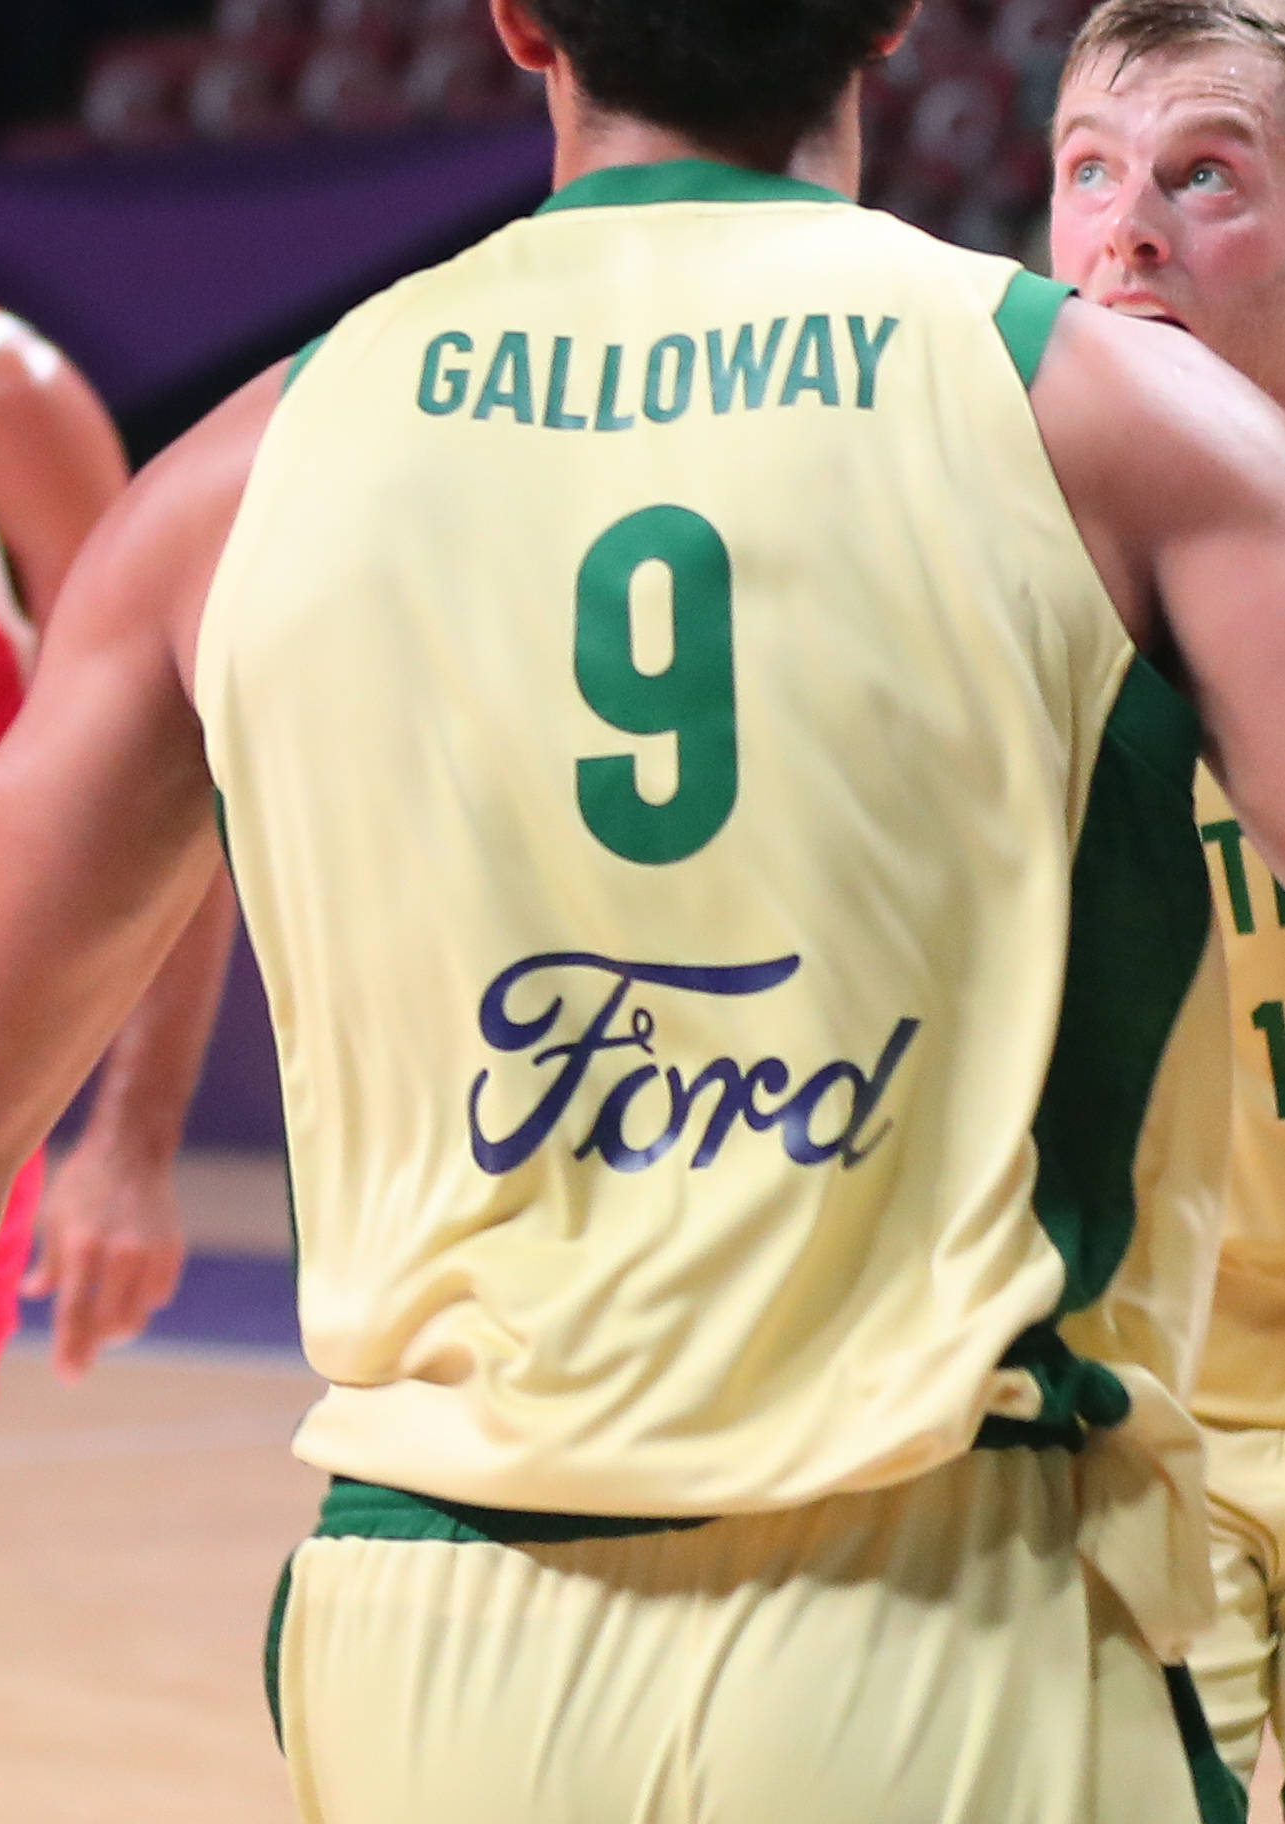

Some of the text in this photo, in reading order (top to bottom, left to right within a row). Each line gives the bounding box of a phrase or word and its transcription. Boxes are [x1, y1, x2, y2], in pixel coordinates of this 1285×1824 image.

[417, 314, 900, 432] GALLOWAY
[574, 504, 739, 865] 9
[469, 952, 921, 1176] Ford
